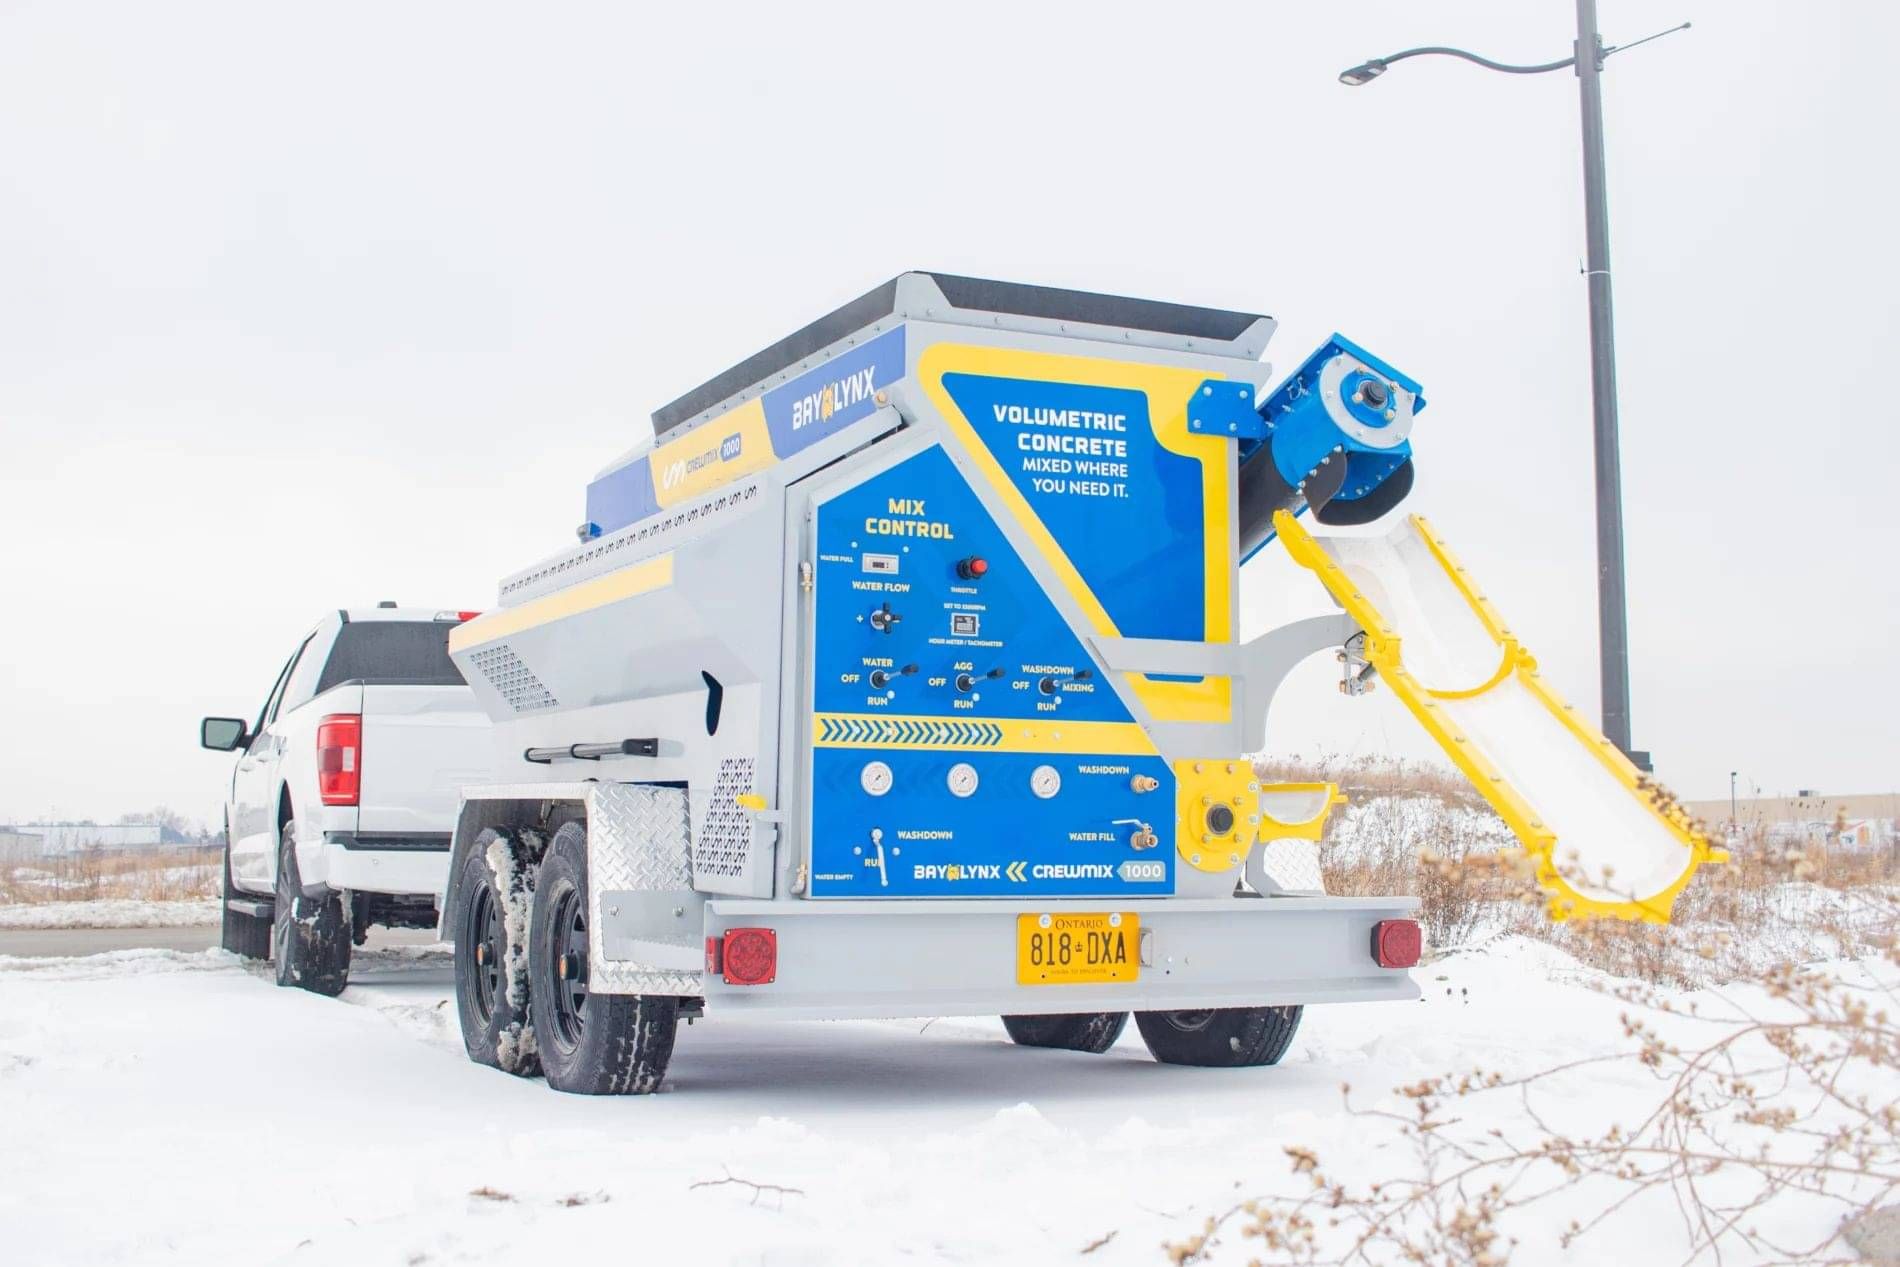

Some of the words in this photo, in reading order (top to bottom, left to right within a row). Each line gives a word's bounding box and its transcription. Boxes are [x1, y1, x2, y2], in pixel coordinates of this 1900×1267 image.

[793, 390, 823, 431] BAY
[833, 365, 875, 412] LYNX
[993, 404, 1127, 432] VOLUMETRIC
[722, 437, 740, 457] 1000
[1017, 432, 1127, 457] CONCRETE
[1022, 457, 1072, 474] MIXED
[1075, 461, 1128, 478] WHERE
[1032, 478, 1066, 494] YOU
[1069, 482, 1110, 497] NEED
[1113, 484, 1129, 498] IT.
[888, 497, 926, 516] MIX
[865, 517, 954, 540] CONTROL
[852, 580, 883, 592] WATER
[884, 582, 911, 593] FLOW
[863, 657, 894, 668] WATER
[954, 662, 973, 671] AGG
[1021, 665, 1075, 675] WASHDOWN
[841, 674, 860, 684] OFF
[928, 677, 947, 687] OFF
[1012, 681, 1030, 690] OFF
[1062, 684, 1095, 693] MIXING
[867, 696, 888, 706] RUN
[953, 699, 974, 709] RUN
[1037, 702, 1057, 712] RUN
[1078, 765, 1130, 775] WASHDOWN
[897, 831, 953, 840] WASHDOWN
[1068, 832, 1098, 841] WATER
[1098, 833, 1116, 841] FILL
[914, 865, 948, 879] BAY
[960, 865, 1001, 879] LYNX
[1032, 864, 1114, 879] CREWMIX
[1125, 864, 1162, 878] 1000
[1055, 919, 1103, 930] ONTARIO
[1031, 932, 1071, 966] 818
[1087, 931, 1126, 965] DXA
